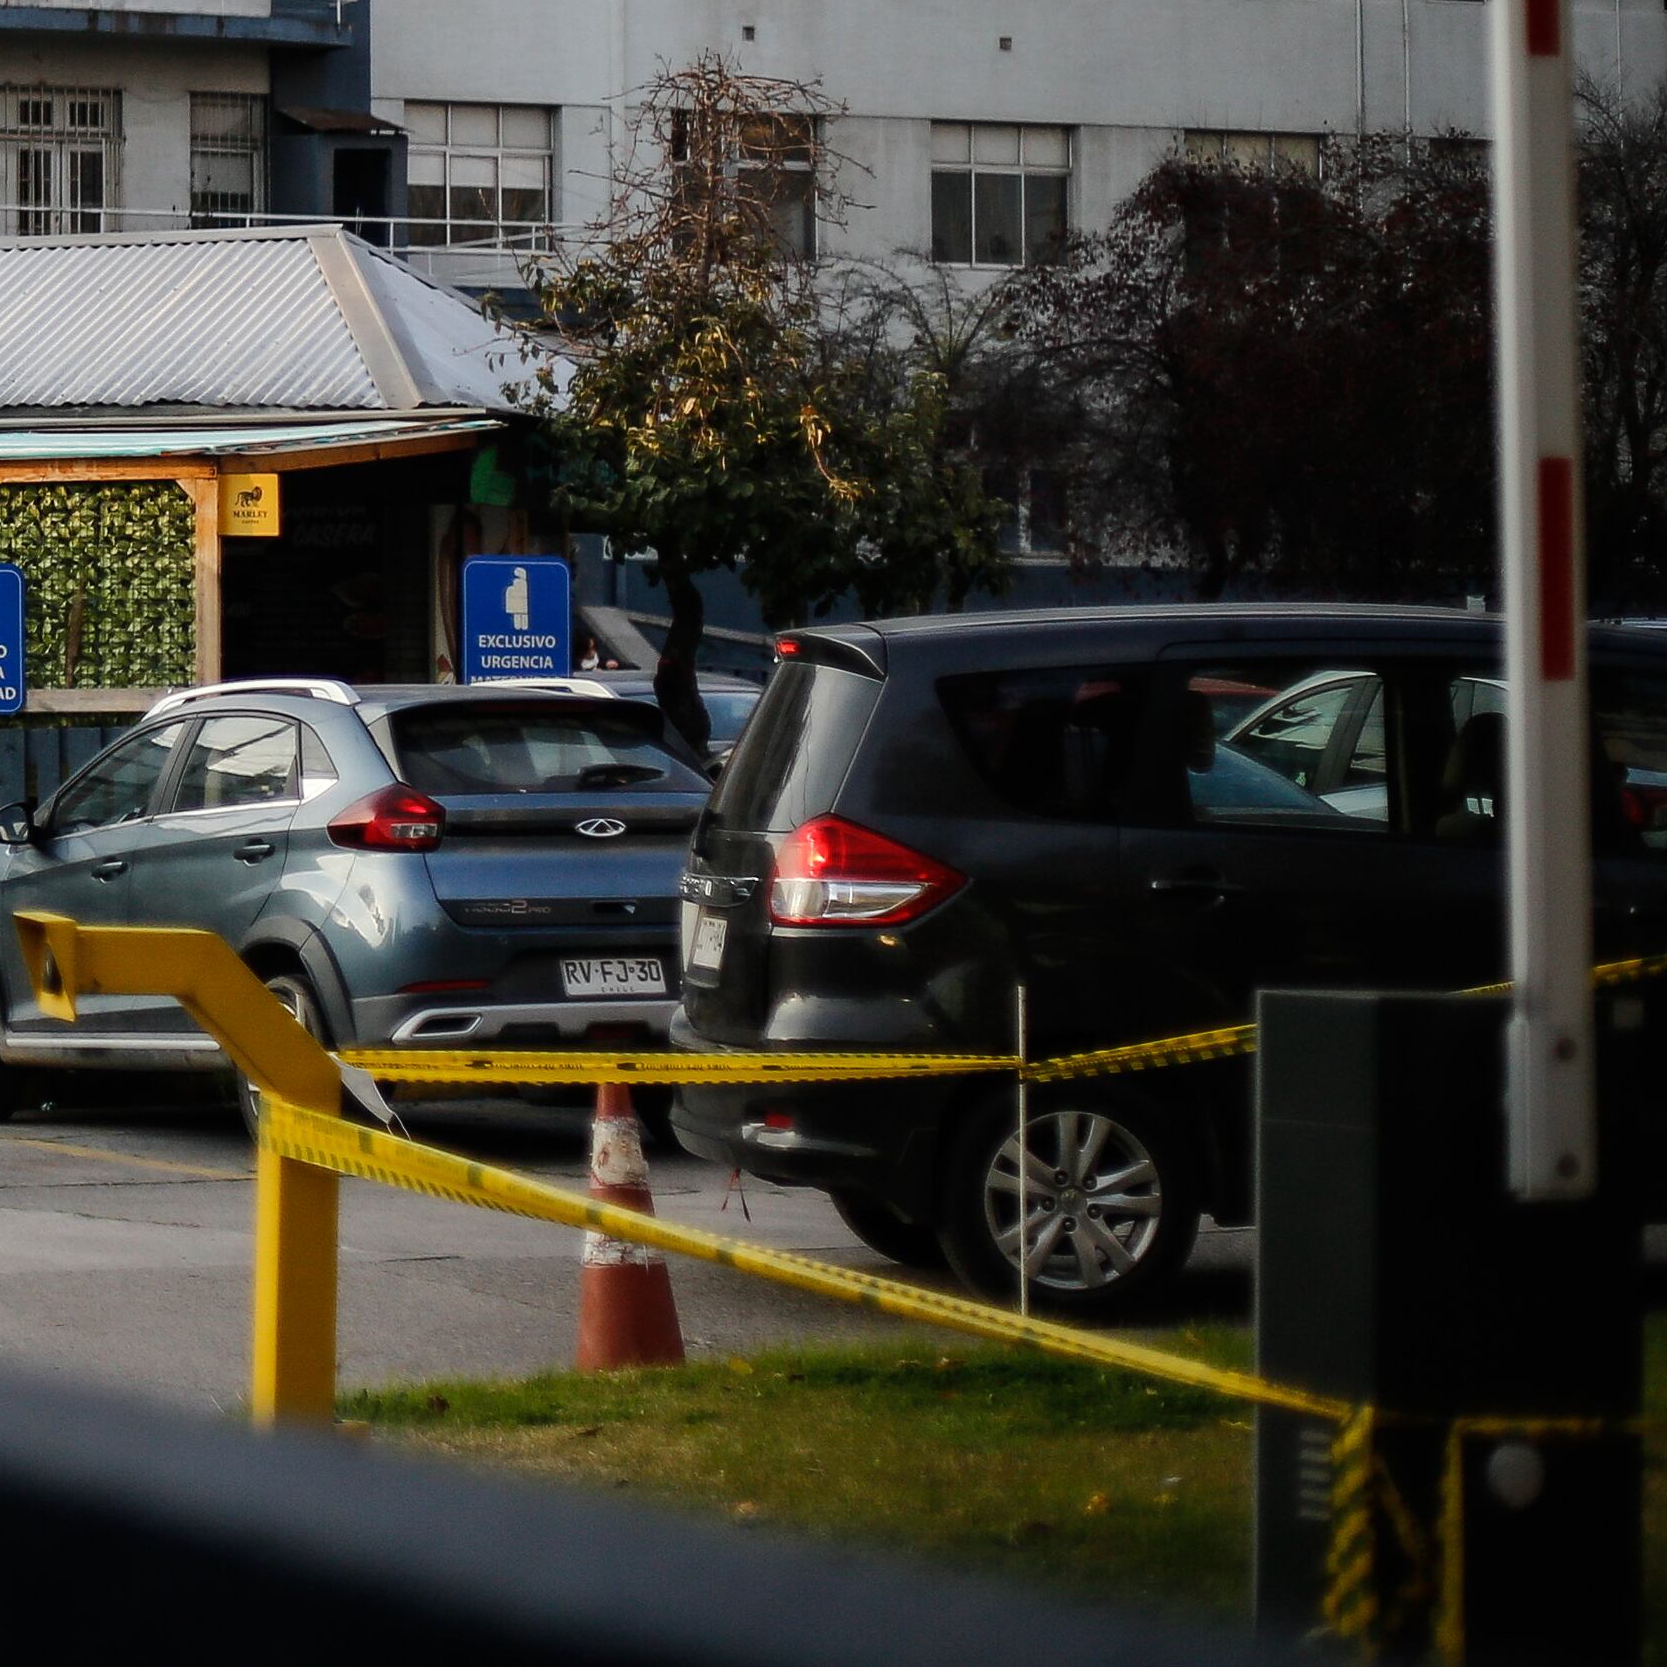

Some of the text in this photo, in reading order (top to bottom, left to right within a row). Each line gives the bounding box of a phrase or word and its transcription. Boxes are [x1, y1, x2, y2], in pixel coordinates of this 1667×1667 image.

[233, 510, 268, 519] MARLEY
[478, 634, 556, 649] EXCLUSIVO
[481, 655, 554, 669] URGENCIA
